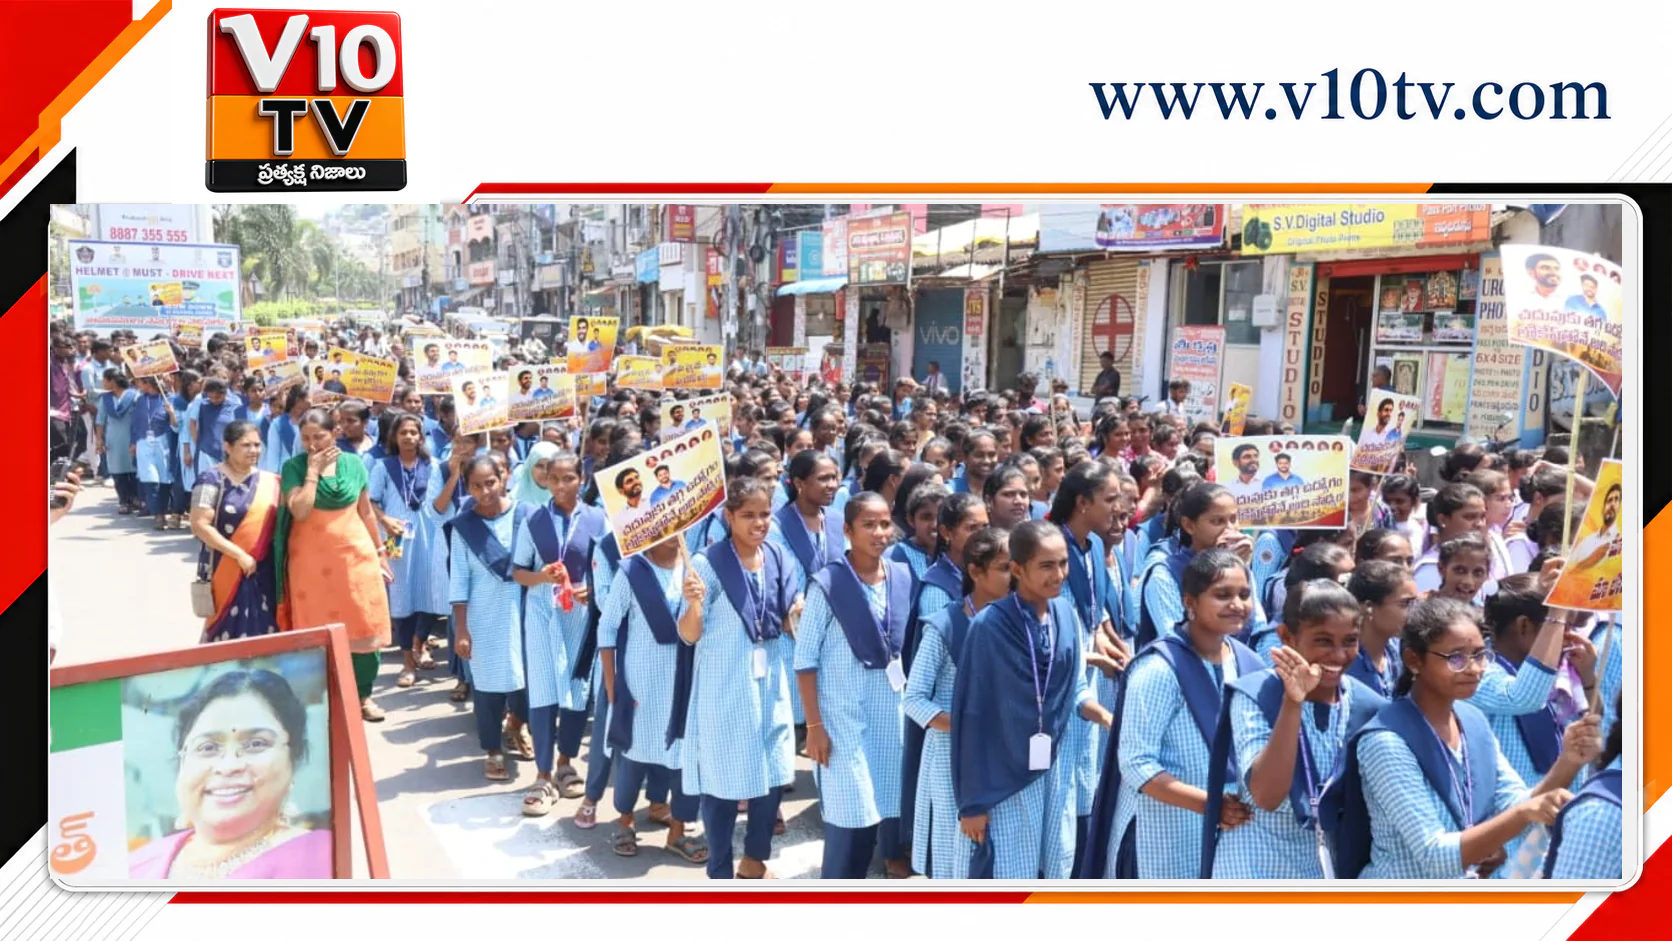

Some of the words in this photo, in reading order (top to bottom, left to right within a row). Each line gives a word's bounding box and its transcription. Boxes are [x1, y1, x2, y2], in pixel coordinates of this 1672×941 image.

[1340, 208, 1385, 226] Studio
[110, 227, 138, 240] 8887
[141, 227, 163, 241] 355
[167, 229, 188, 243] 555
[76, 267, 119, 277] HELMET
[133, 269, 163, 278] MUST
[172, 269, 204, 279] DRIVE
[1310, 291, 1327, 395] STUDIO
[1282, 311, 1304, 420] STUDIO
[1498, 353, 1522, 366] SIZE
[1235, 488, 1278, 506] దువుకు
[1302, 477, 1344, 494] ఉద్యోగం
